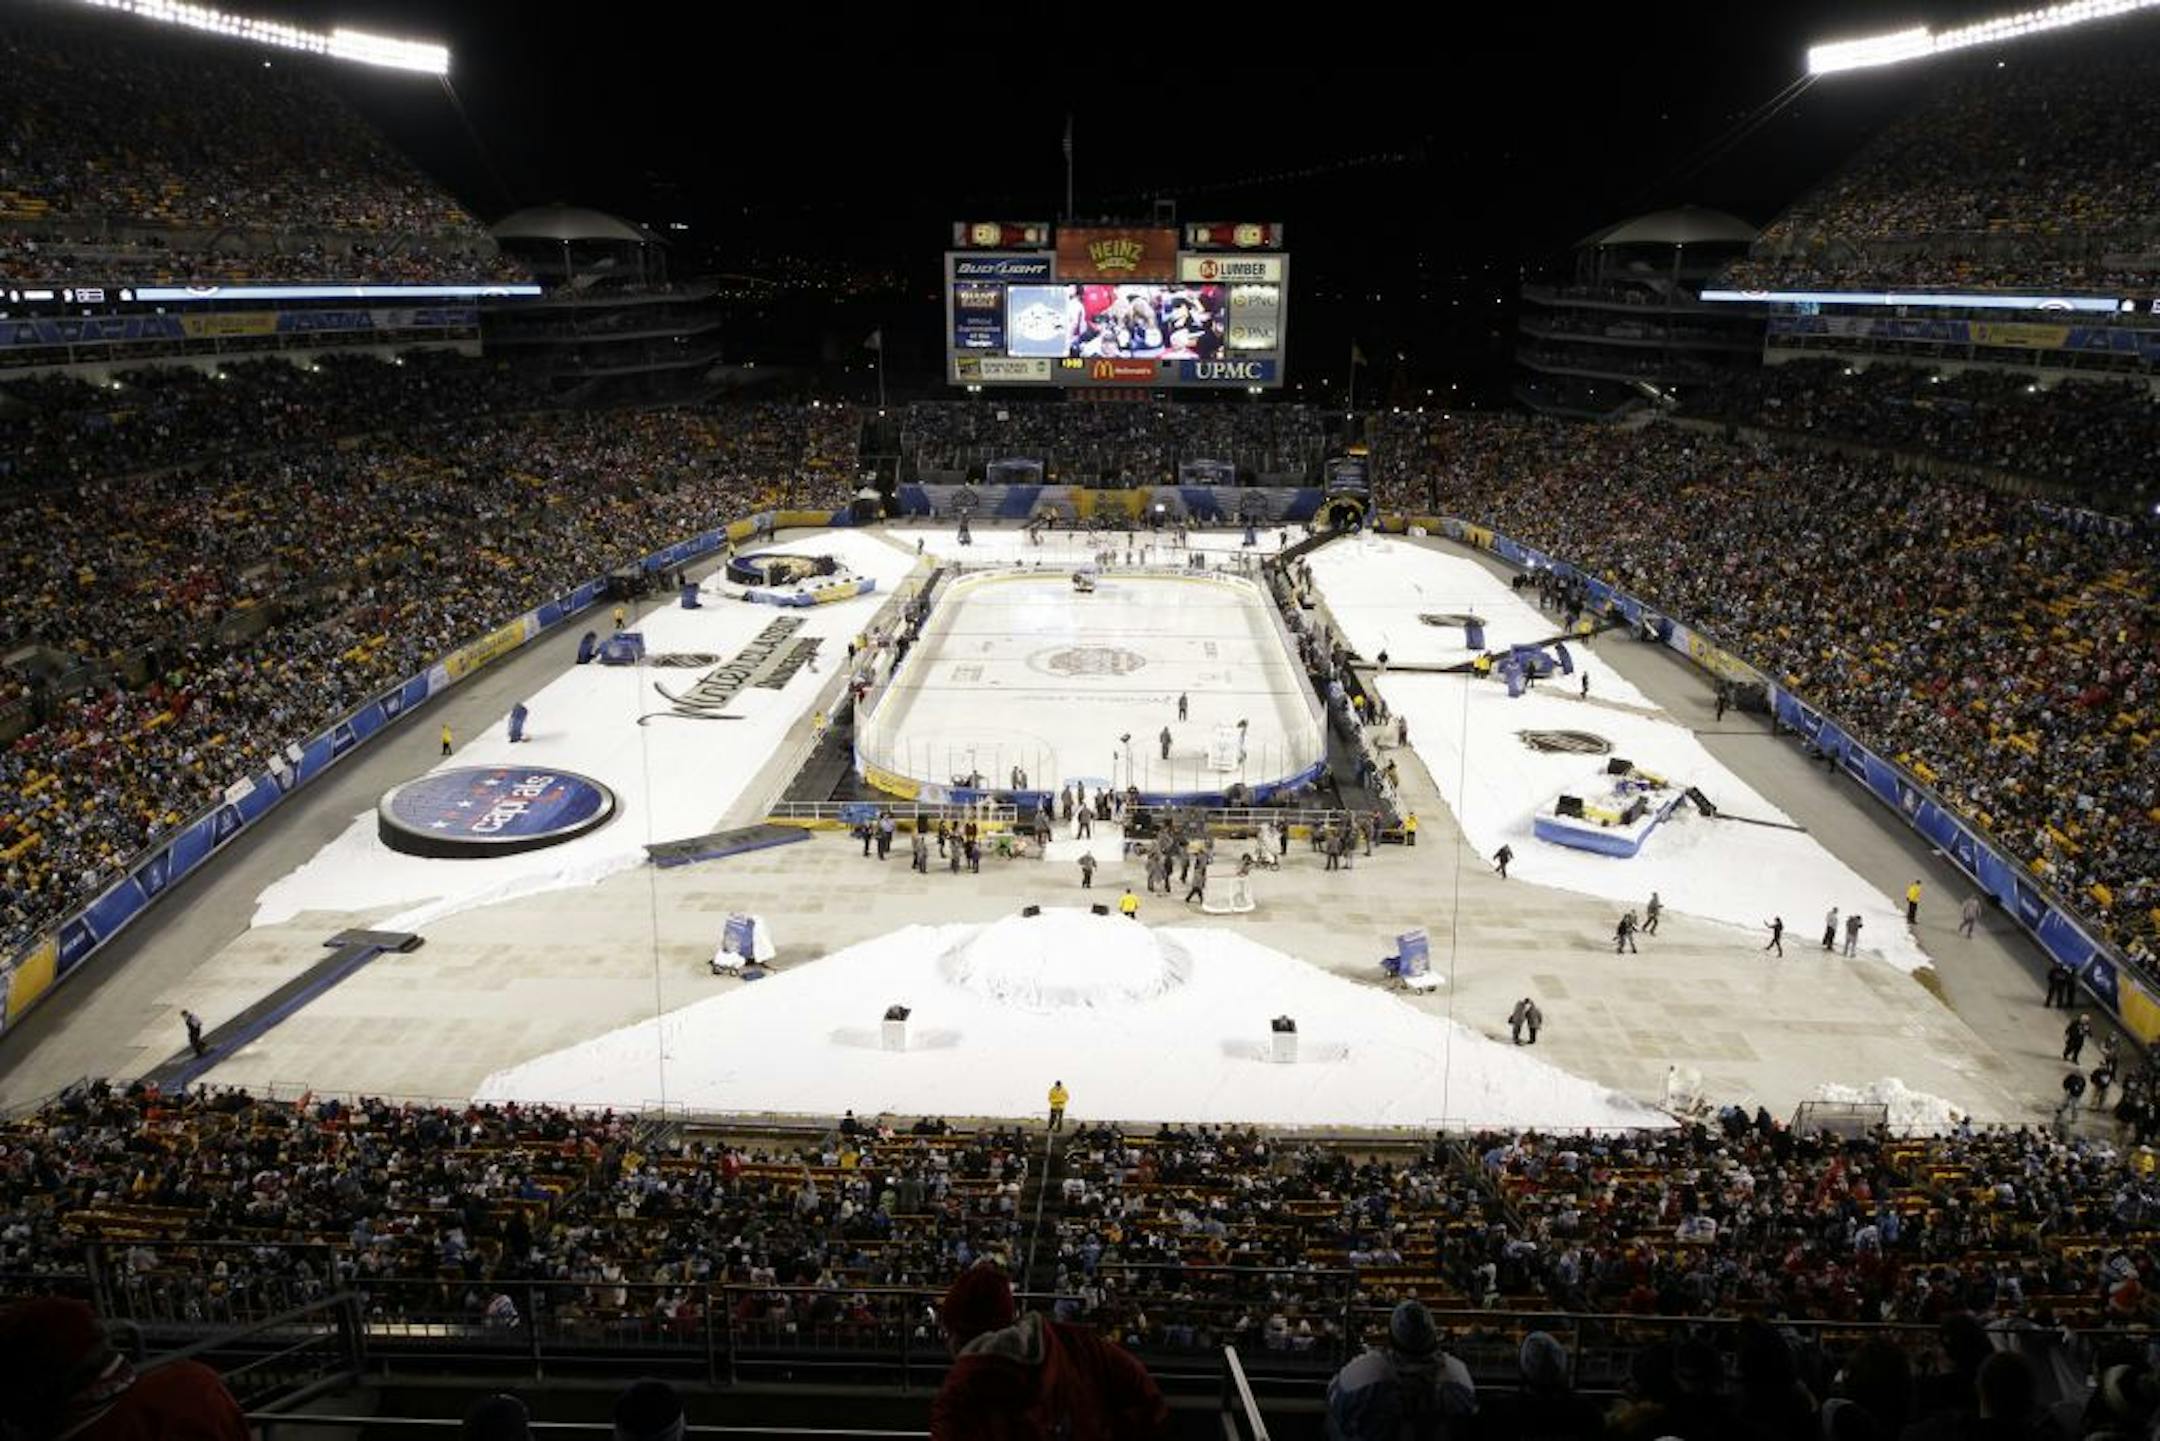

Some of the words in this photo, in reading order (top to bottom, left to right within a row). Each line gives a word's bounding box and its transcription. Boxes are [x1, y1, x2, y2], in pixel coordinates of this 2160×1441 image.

[1089, 239, 1144, 260] HEINZ
[1221, 263, 1266, 276] LUMBER
[1248, 295, 1277, 306] PNC
[1247, 327, 1274, 338] PNC
[1195, 361, 1263, 380] UPMC
